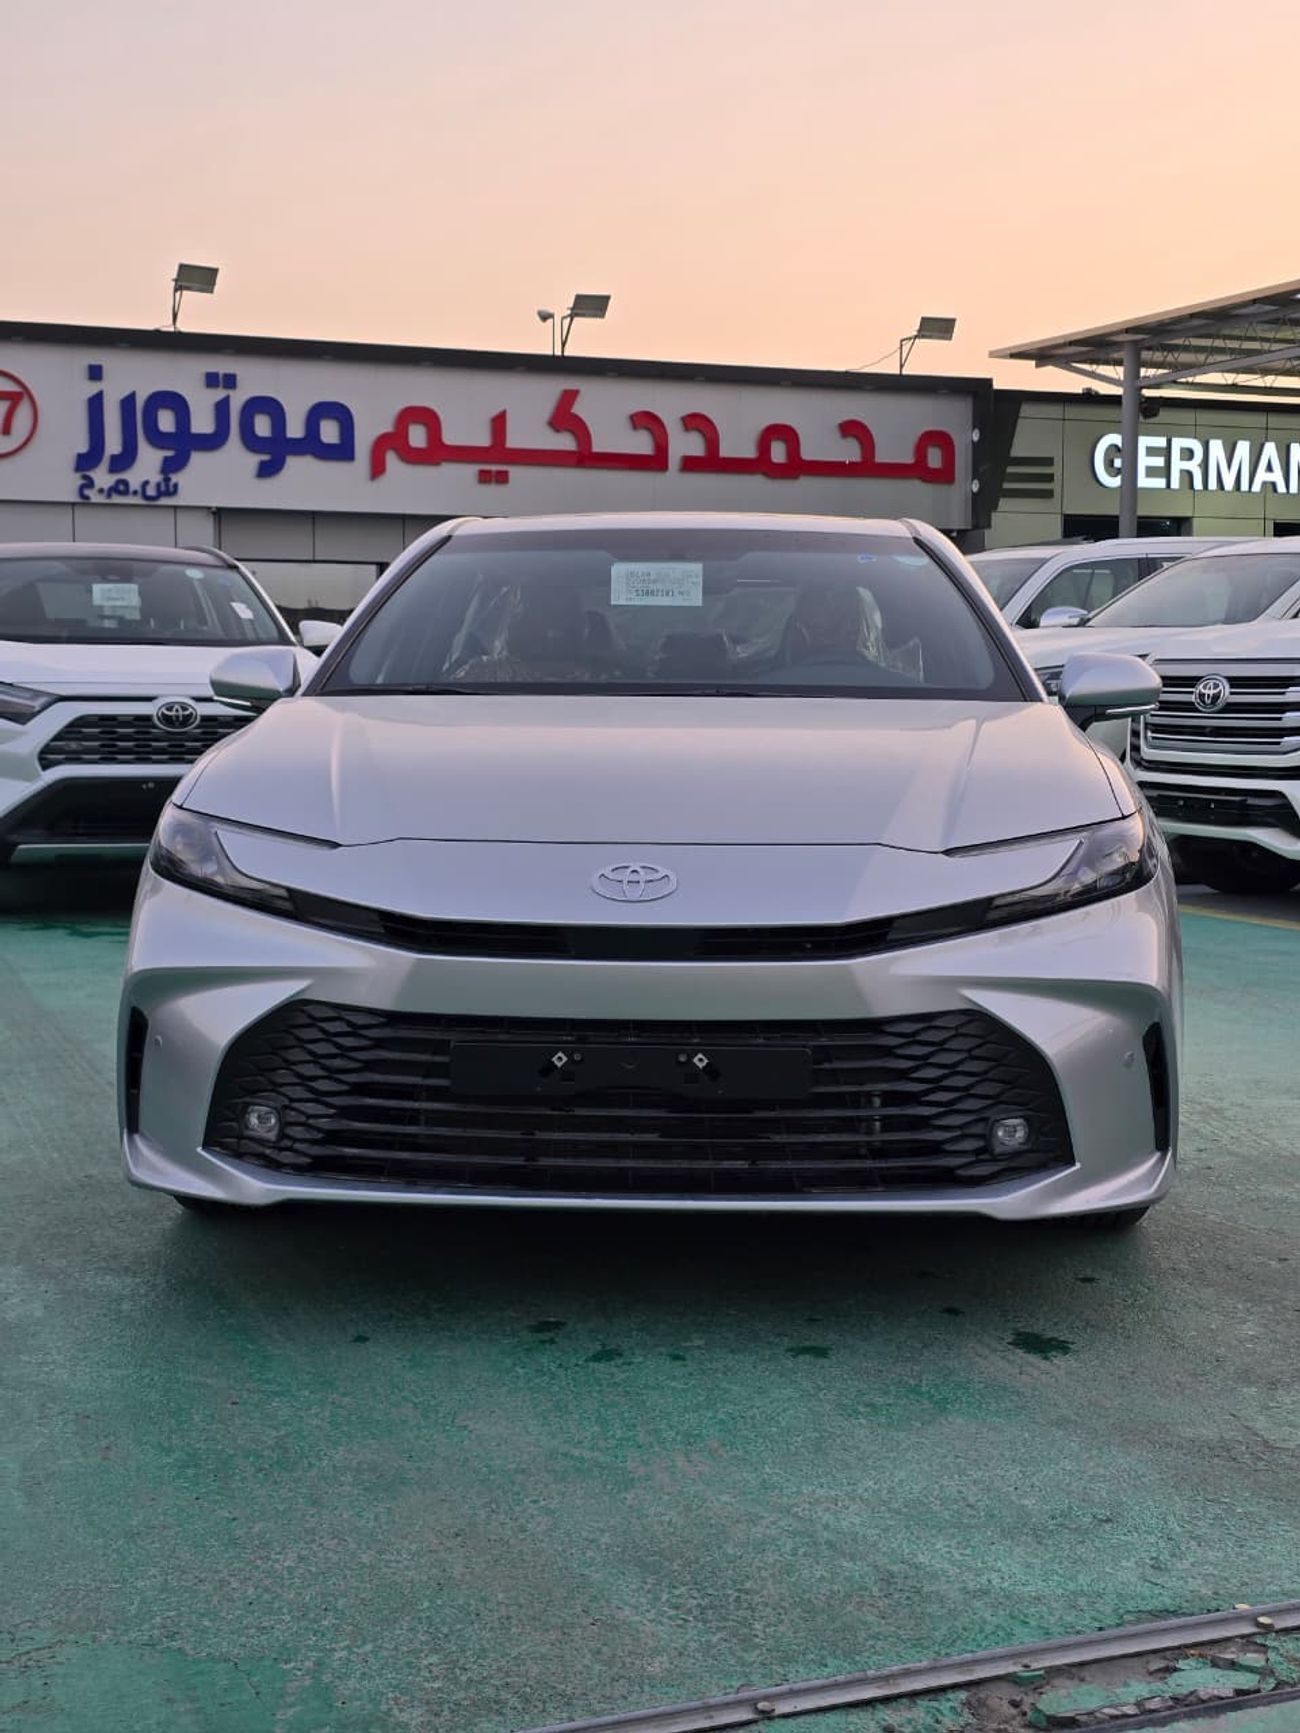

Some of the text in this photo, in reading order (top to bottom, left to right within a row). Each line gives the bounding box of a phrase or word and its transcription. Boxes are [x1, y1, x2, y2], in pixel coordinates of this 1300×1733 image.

[74, 364, 956, 484] محمد حكيم موتورز
